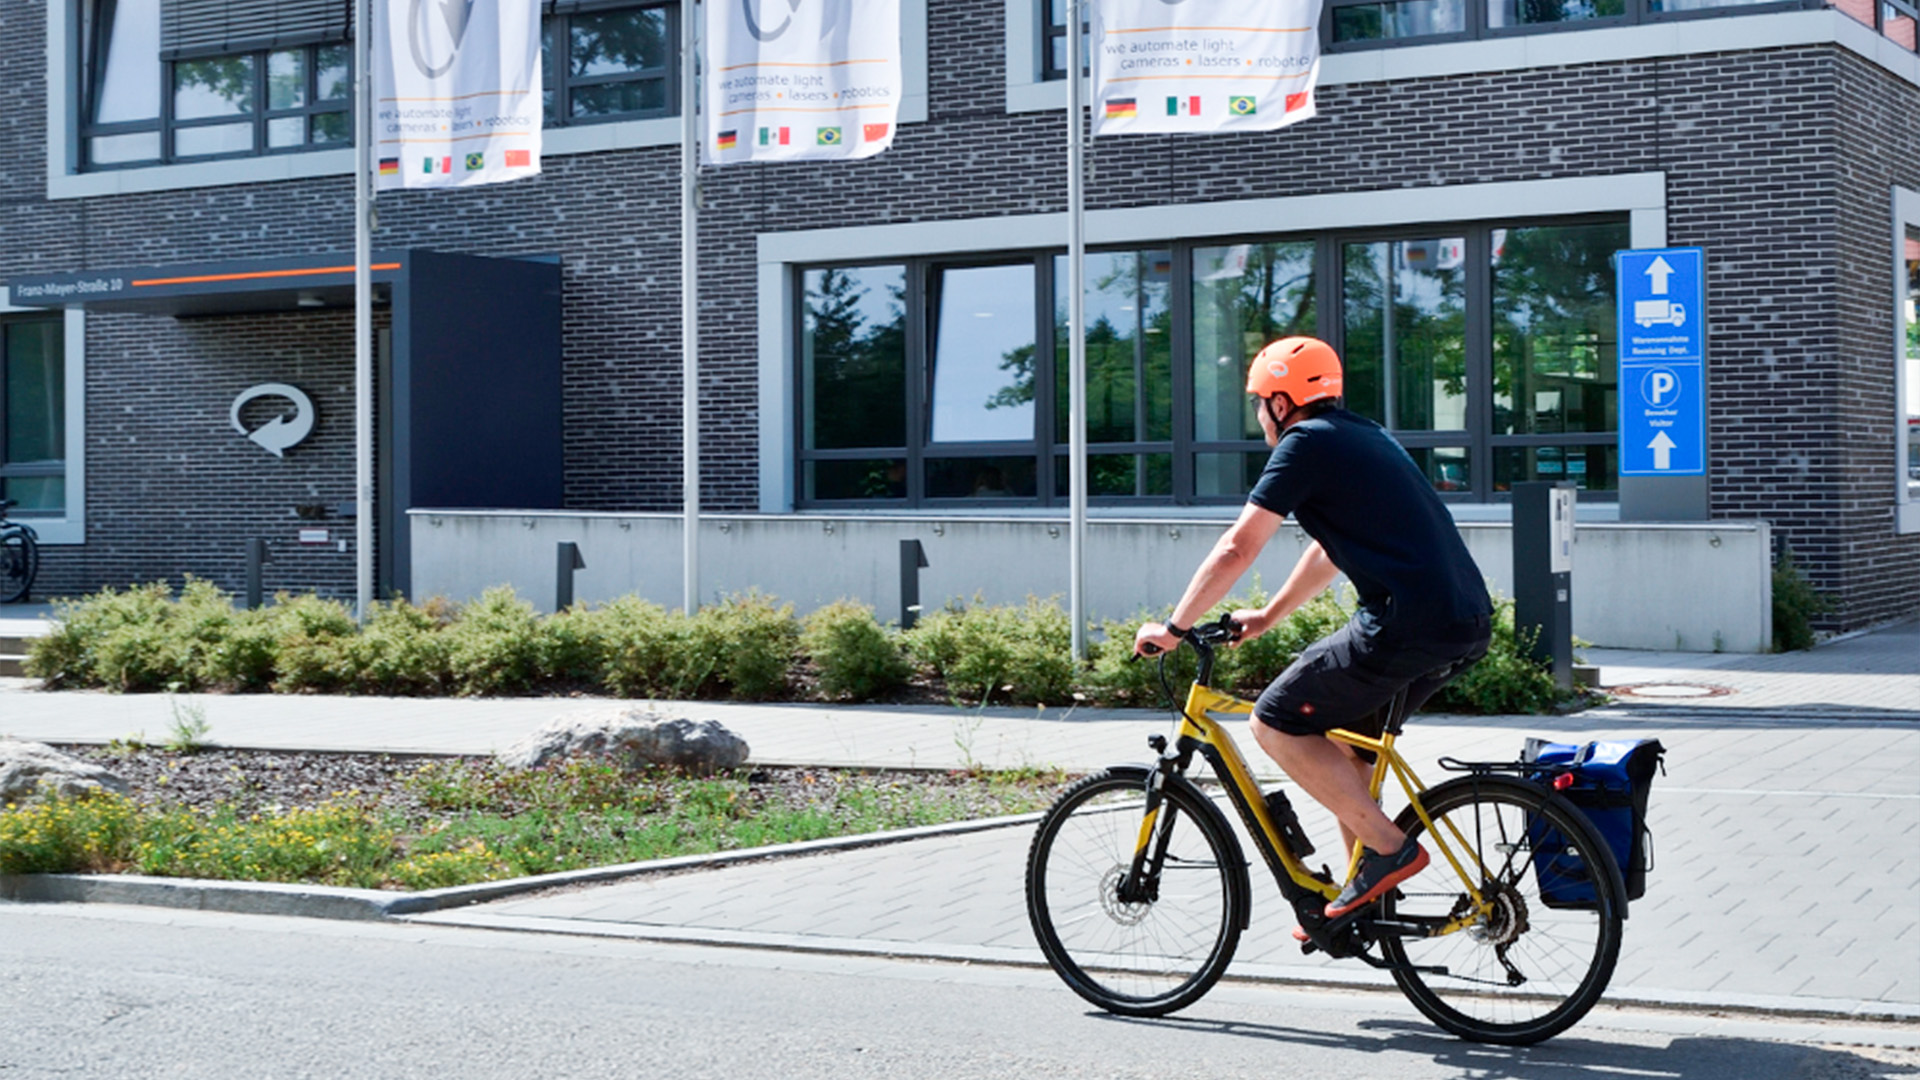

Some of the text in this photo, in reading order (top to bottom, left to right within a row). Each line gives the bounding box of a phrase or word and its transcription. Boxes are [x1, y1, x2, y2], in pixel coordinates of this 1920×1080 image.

[1105, 38, 1235, 54] we automate light
[1120, 56, 1180, 69] cameras
[1199, 54, 1241, 67] lasers
[718, 74, 824, 90] we automate light
[788, 90, 829, 101] lasers
[841, 85, 890, 99] robotics
[394, 108, 453, 119] automate
[484, 113, 531, 127] robotics
[110, 278, 123, 291] 10
[1632, 347, 1667, 355] Receiving
[1652, 373, 1674, 404] P
[1649, 419, 1673, 427] Visitor
